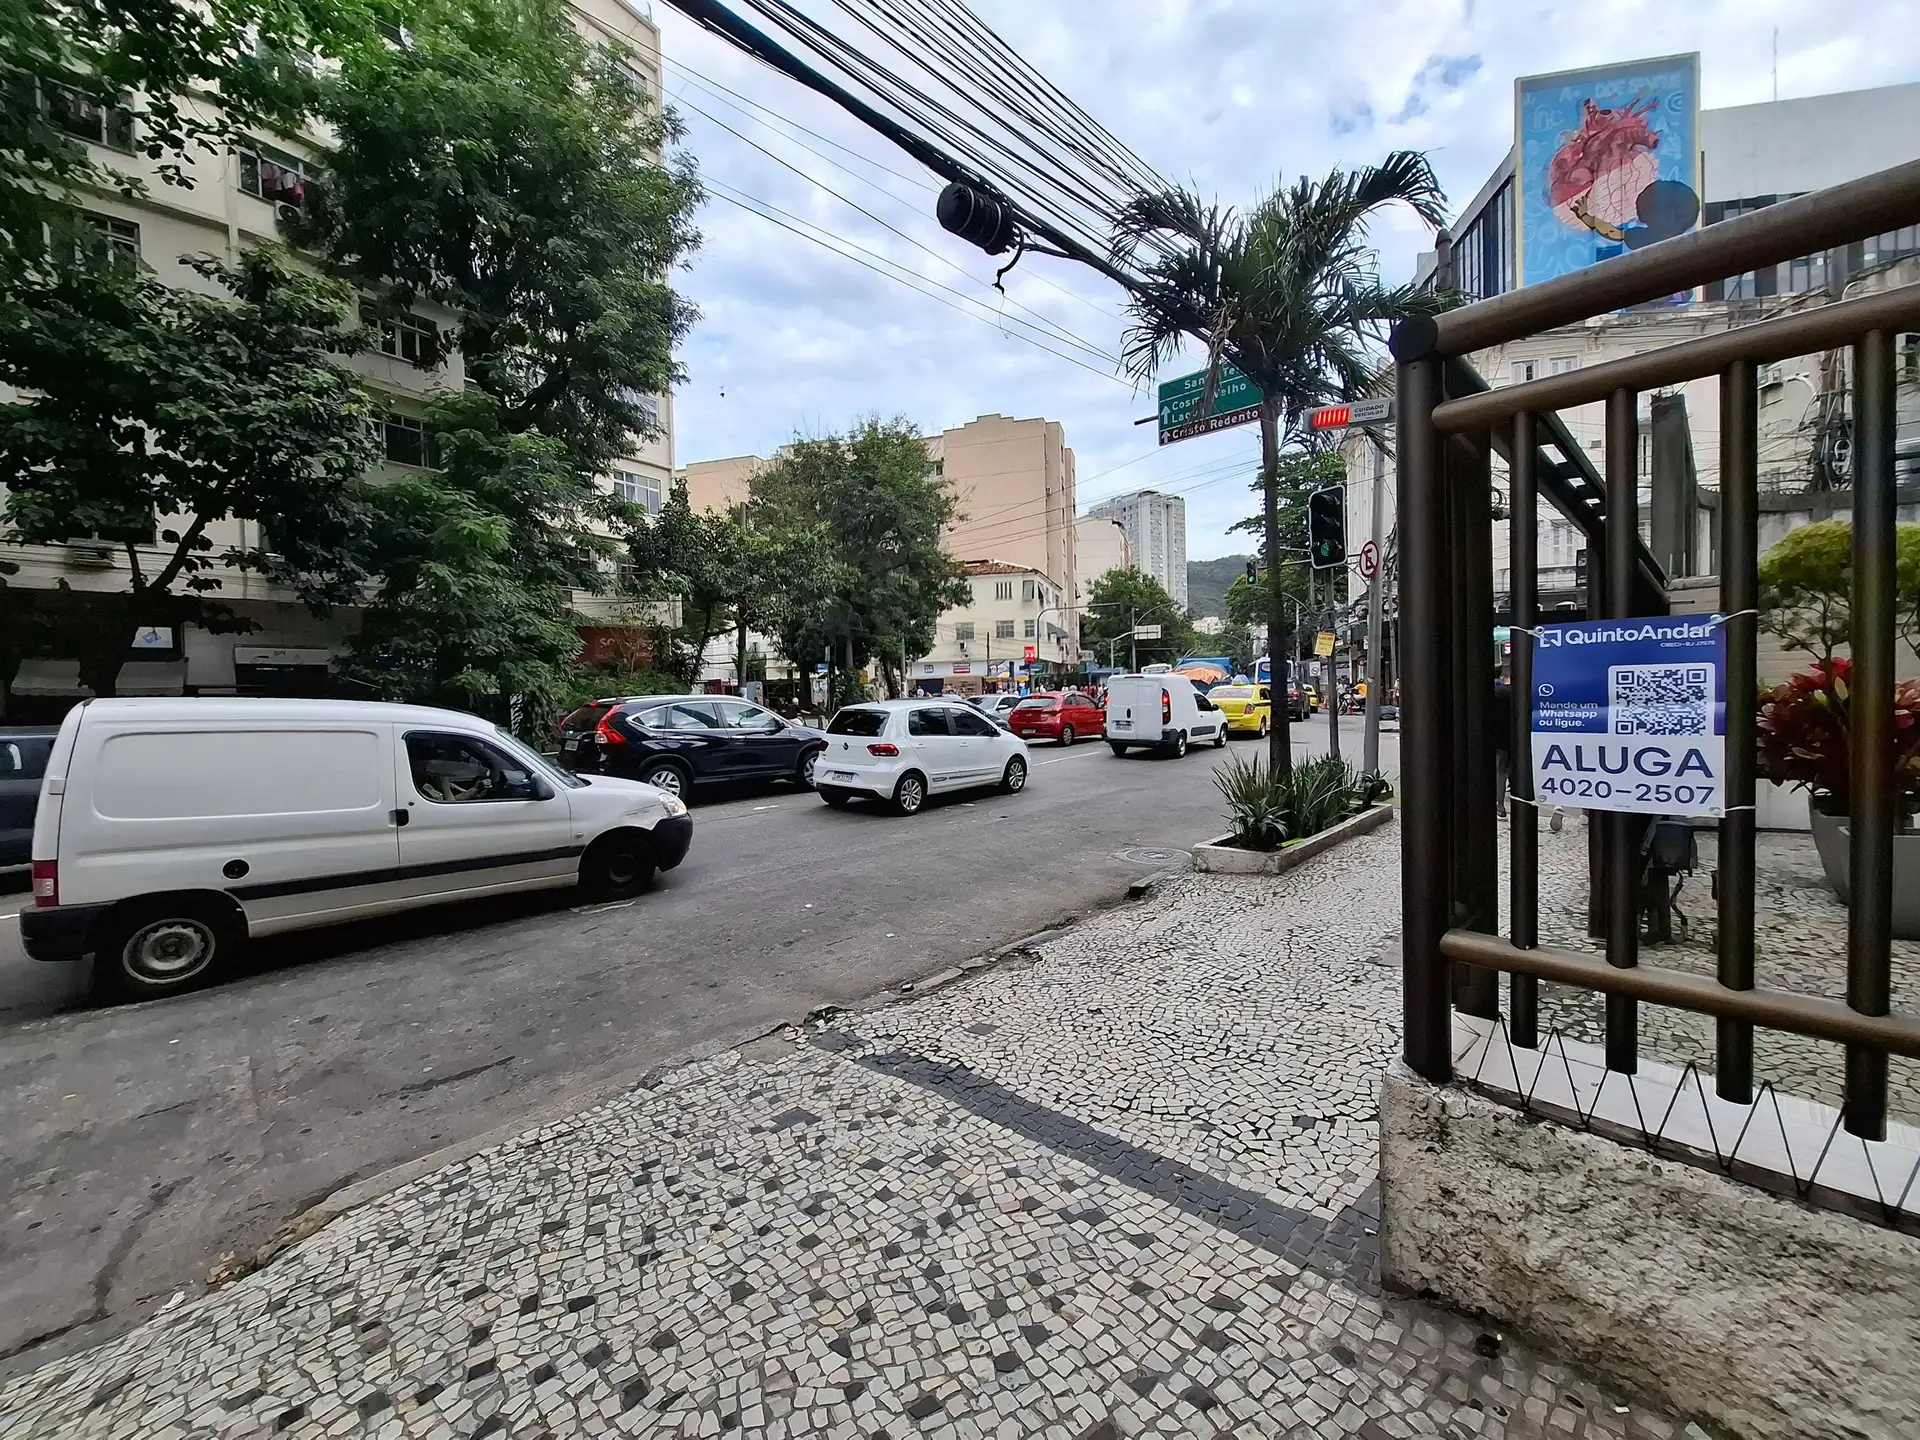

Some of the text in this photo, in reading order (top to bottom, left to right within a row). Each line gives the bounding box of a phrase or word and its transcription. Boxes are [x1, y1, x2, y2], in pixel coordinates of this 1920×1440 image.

[1213, 382, 1247, 399] Velho
[1354, 404, 1385, 413] CUIDADO
[1172, 408, 1262, 439] Cristo Redento
[1565, 623, 1716, 645] QuintoAndar
[1540, 701, 1578, 709] Mande
[1540, 709, 1598, 719] Whatsapp
[1539, 718, 1585, 729] ou ligue.
[1541, 744, 1714, 779] ALUGA
[1541, 777, 1715, 805] 4020-2507
